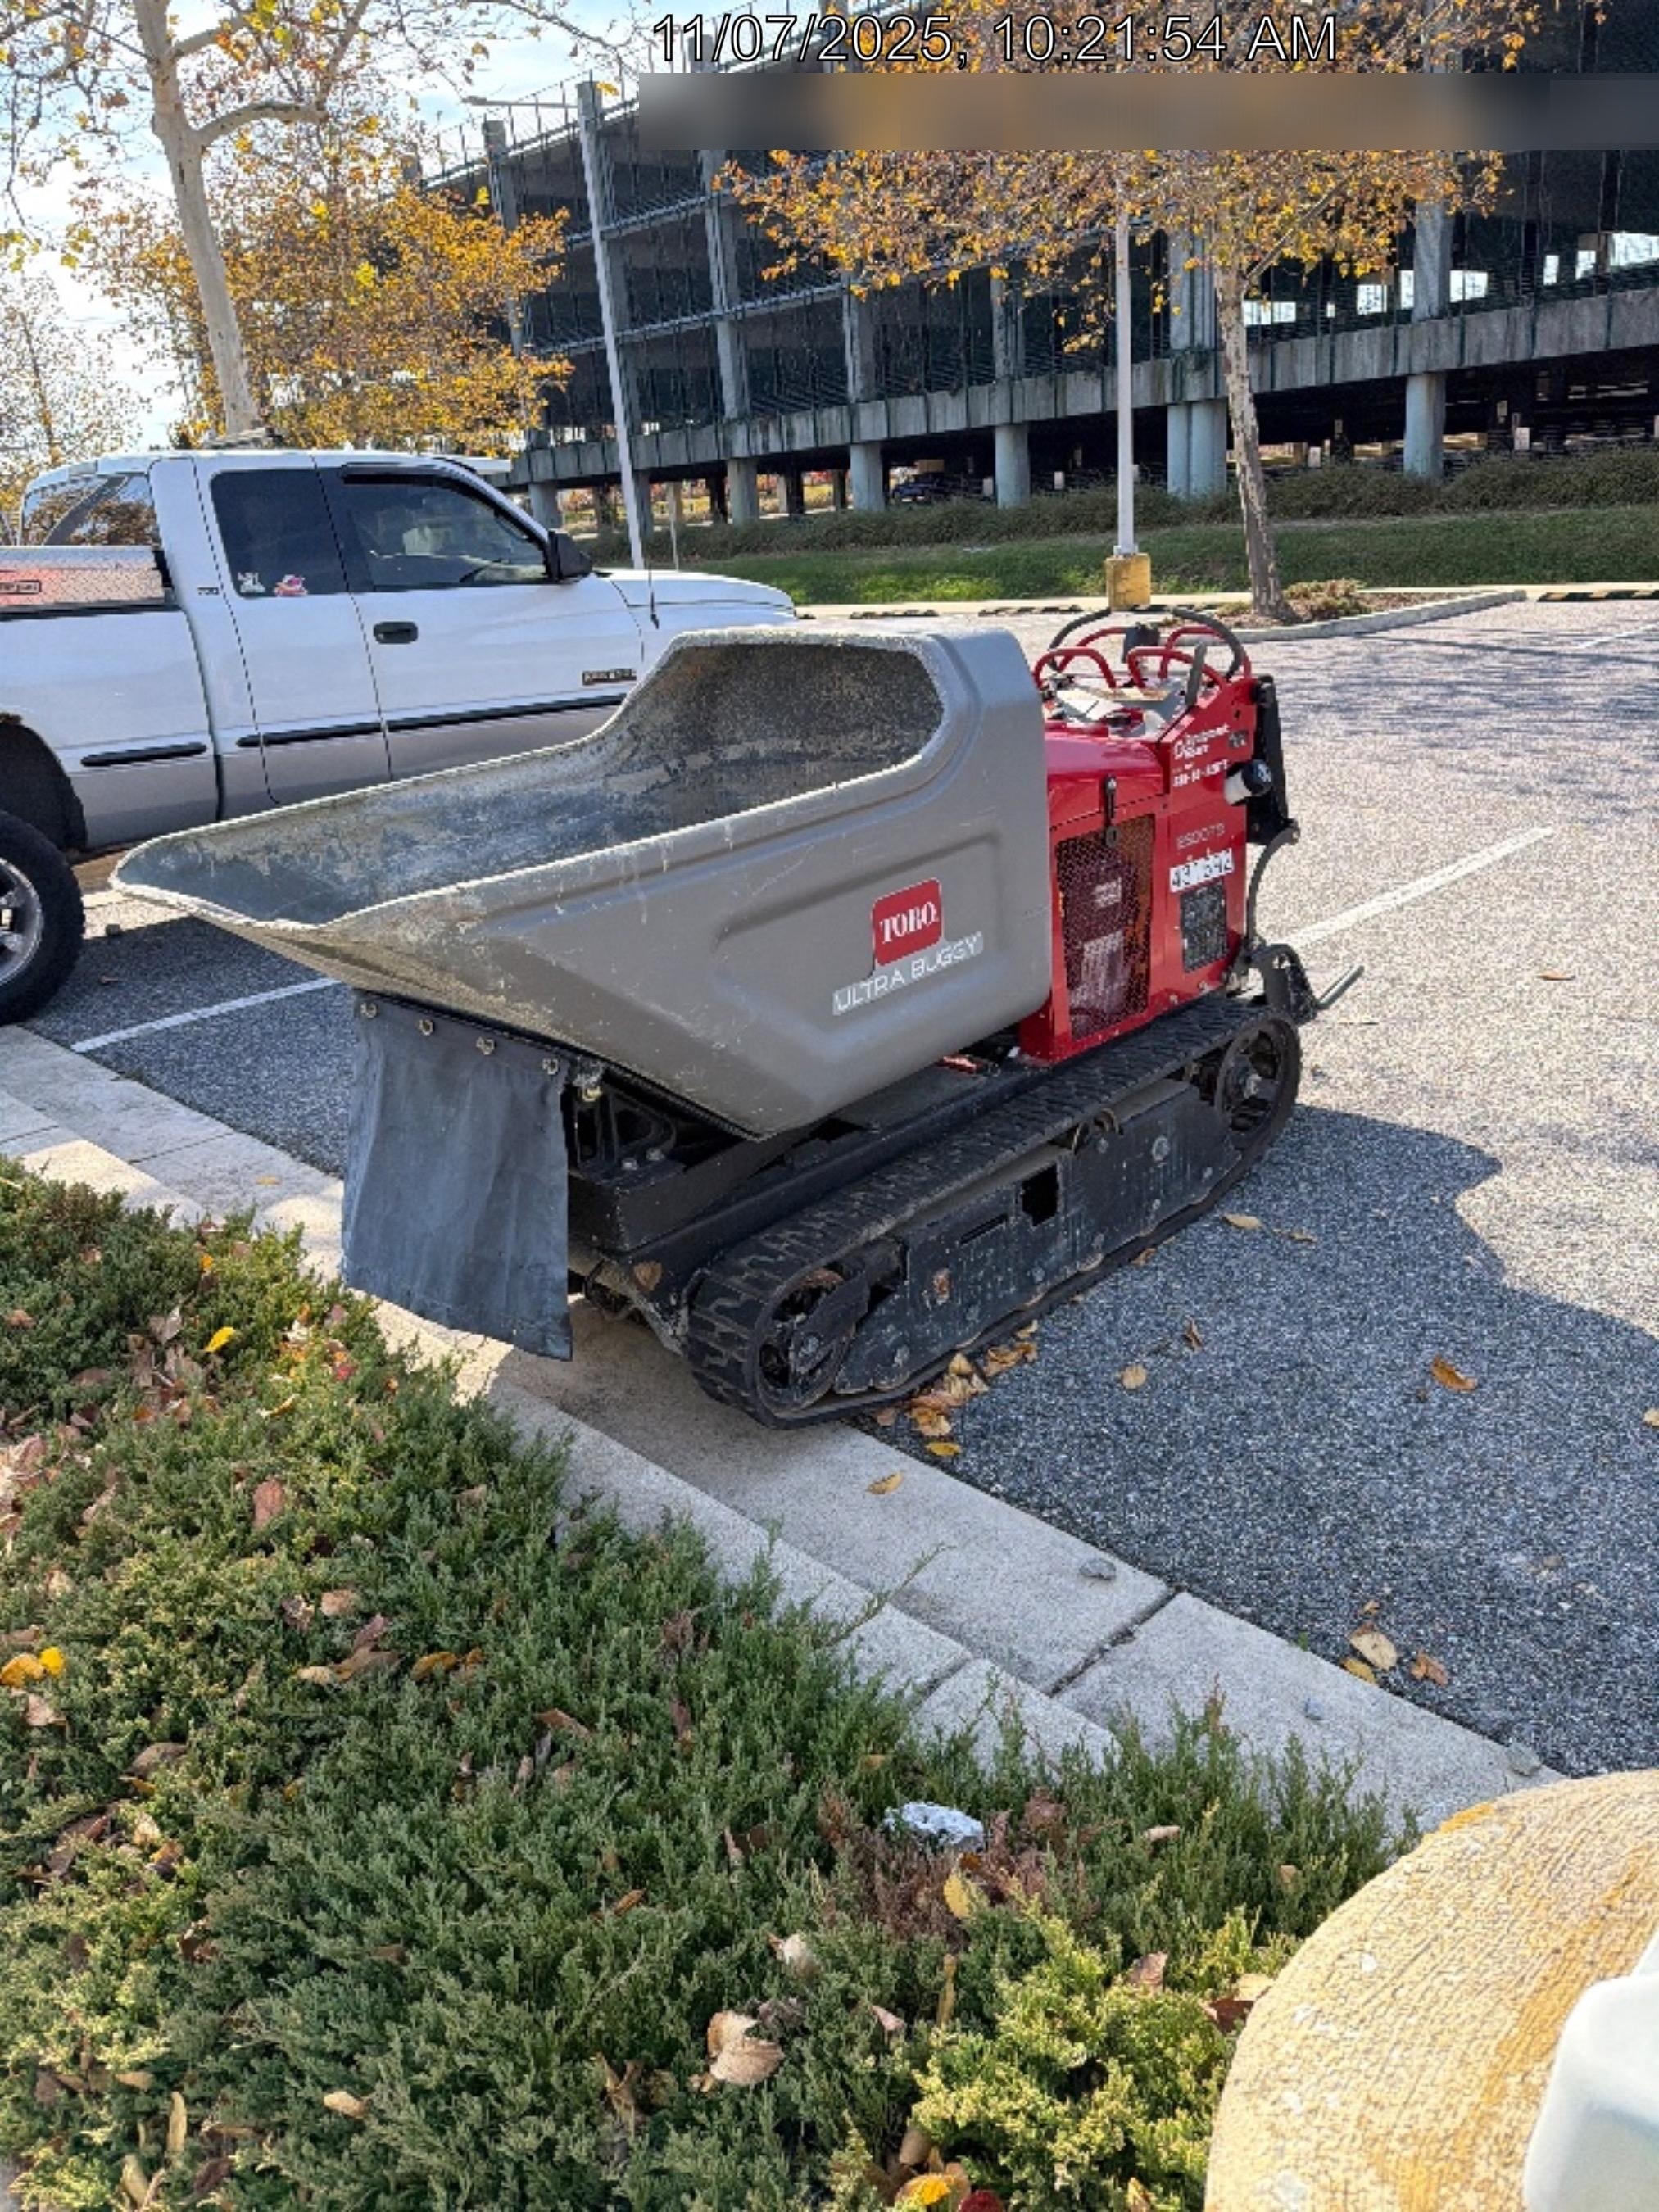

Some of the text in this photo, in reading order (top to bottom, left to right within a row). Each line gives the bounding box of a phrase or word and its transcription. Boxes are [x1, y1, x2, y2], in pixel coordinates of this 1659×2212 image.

[879, 901, 939, 944] TORO
[834, 931, 981, 1013] ULTRA BUGGY
